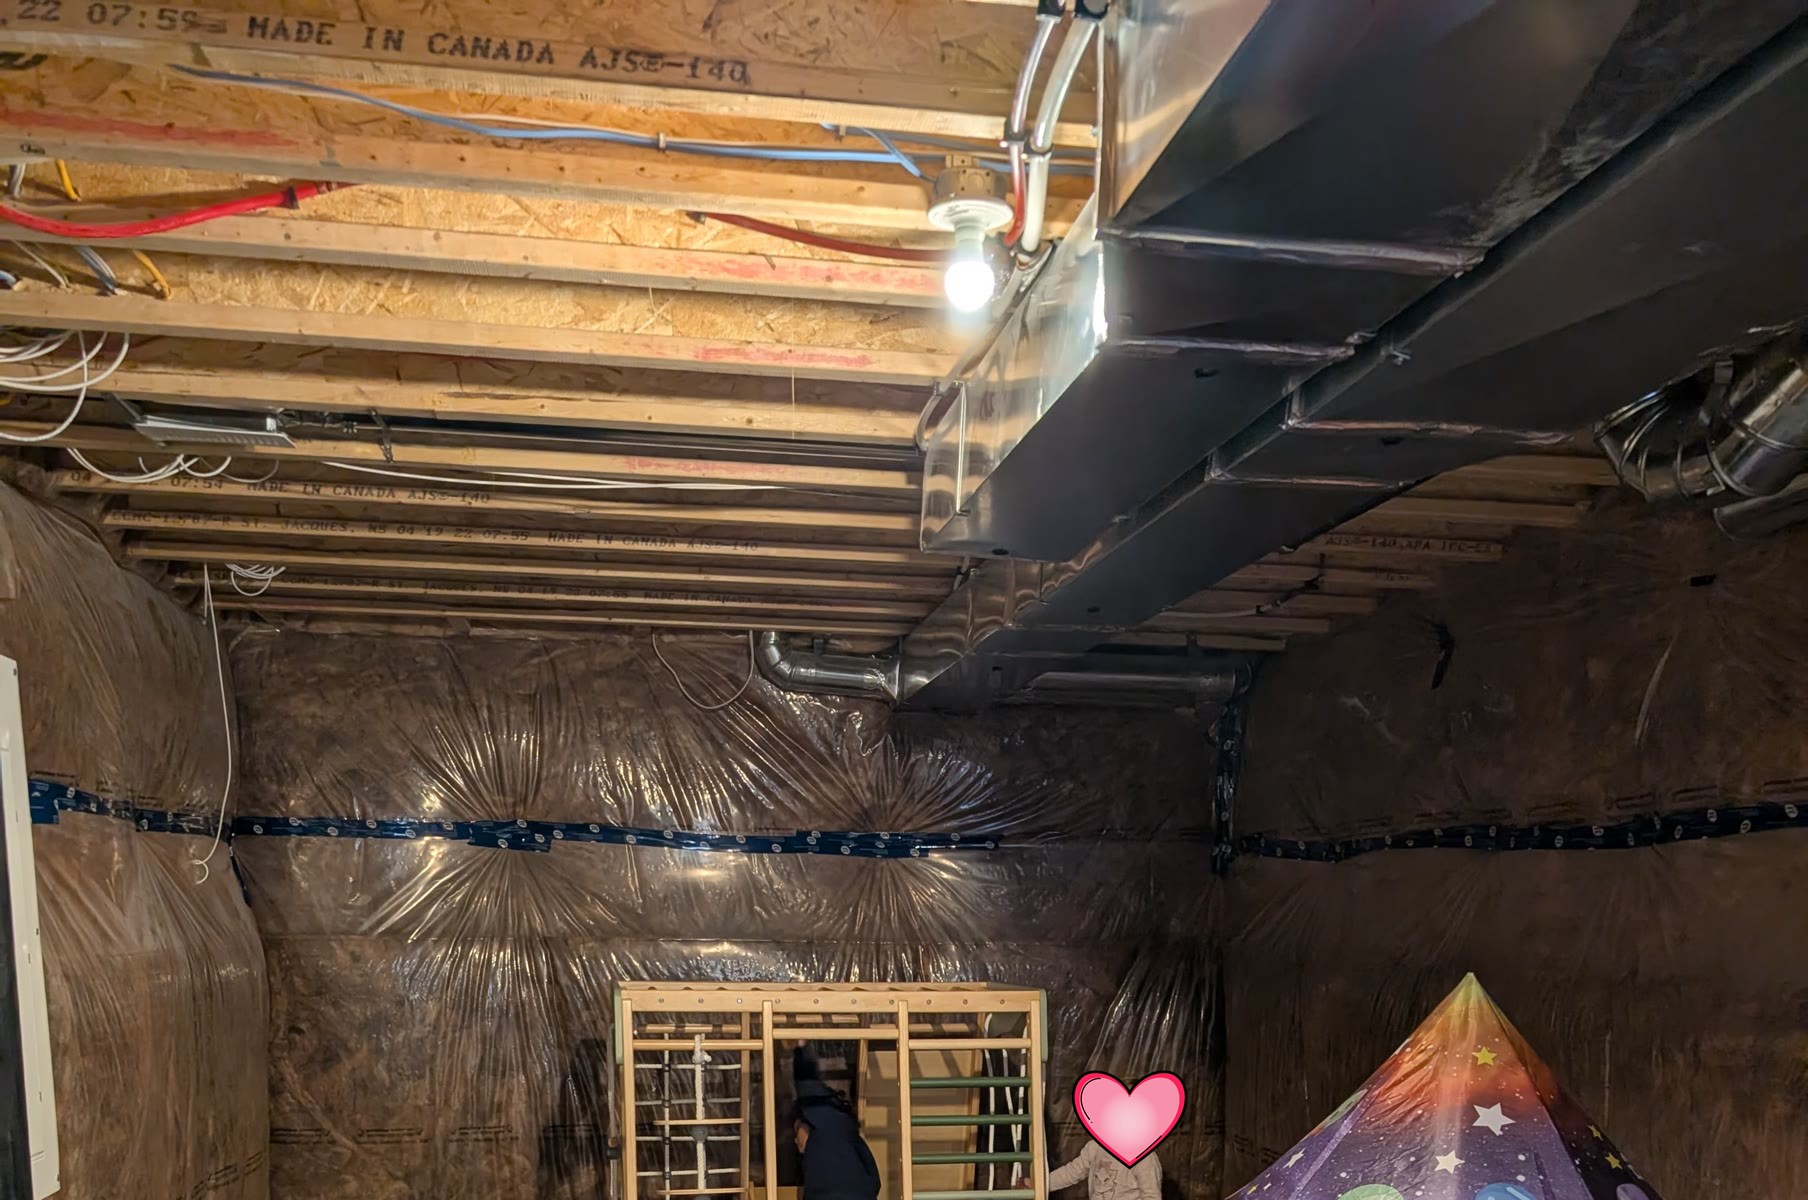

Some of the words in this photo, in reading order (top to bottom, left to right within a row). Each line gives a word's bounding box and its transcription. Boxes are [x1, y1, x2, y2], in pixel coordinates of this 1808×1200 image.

[248, 16, 336, 46] MADE
[363, 26, 405, 51] IN
[428, 33, 554, 65] CANADA
[302, 484, 321, 496] IN
[333, 485, 396, 499] CANADA
[548, 531, 583, 545] MADE
[596, 534, 612, 545] IN
[622, 536, 676, 548] CANADA
